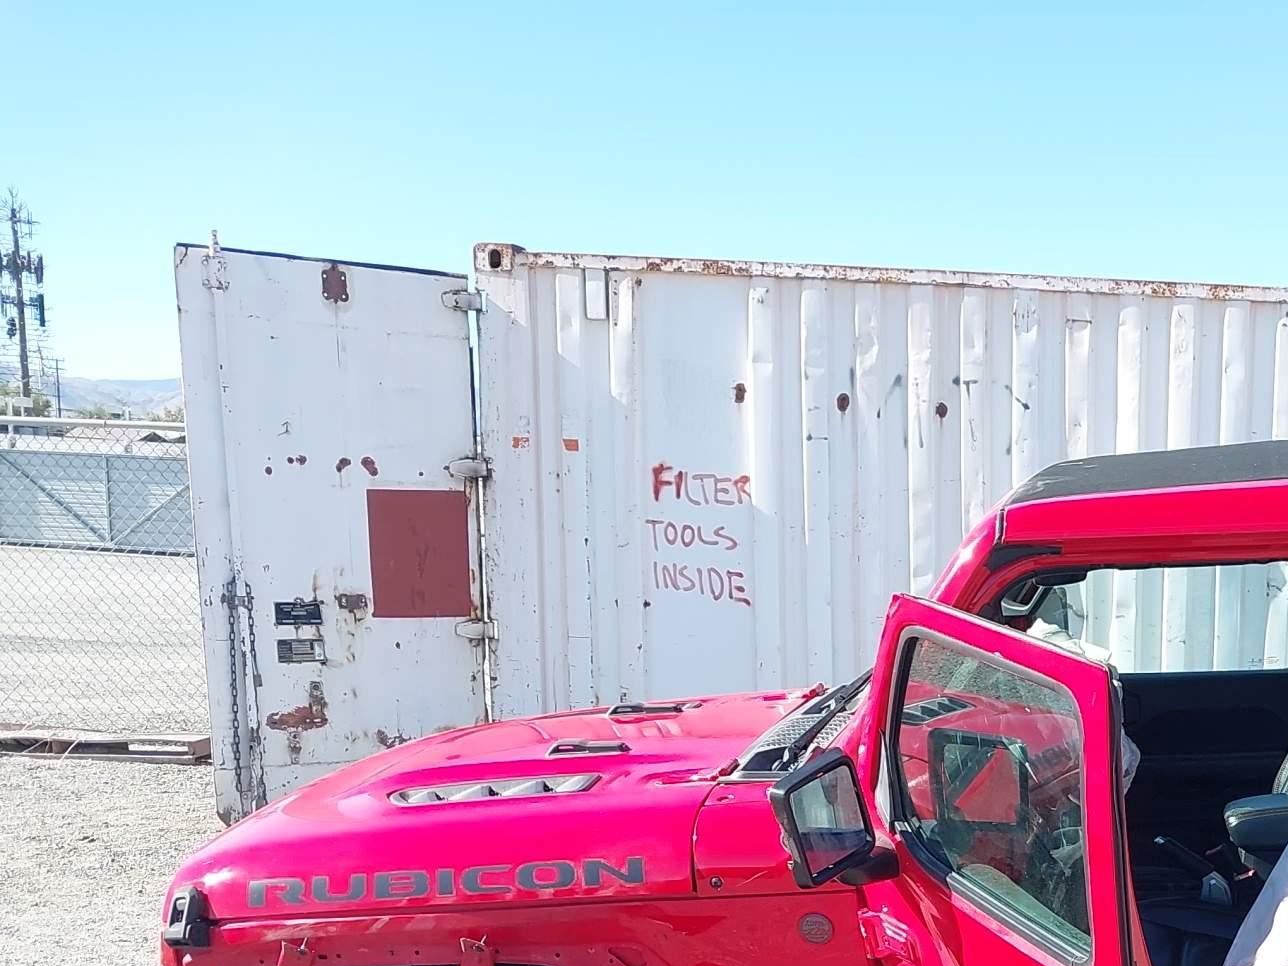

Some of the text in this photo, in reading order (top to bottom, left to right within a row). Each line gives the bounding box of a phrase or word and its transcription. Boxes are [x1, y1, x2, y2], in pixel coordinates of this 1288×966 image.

[652, 463, 751, 506] FILTER
[645, 519, 738, 551] TOOLS
[653, 561, 751, 607] INSIDE
[247, 856, 645, 907] RUBICON
